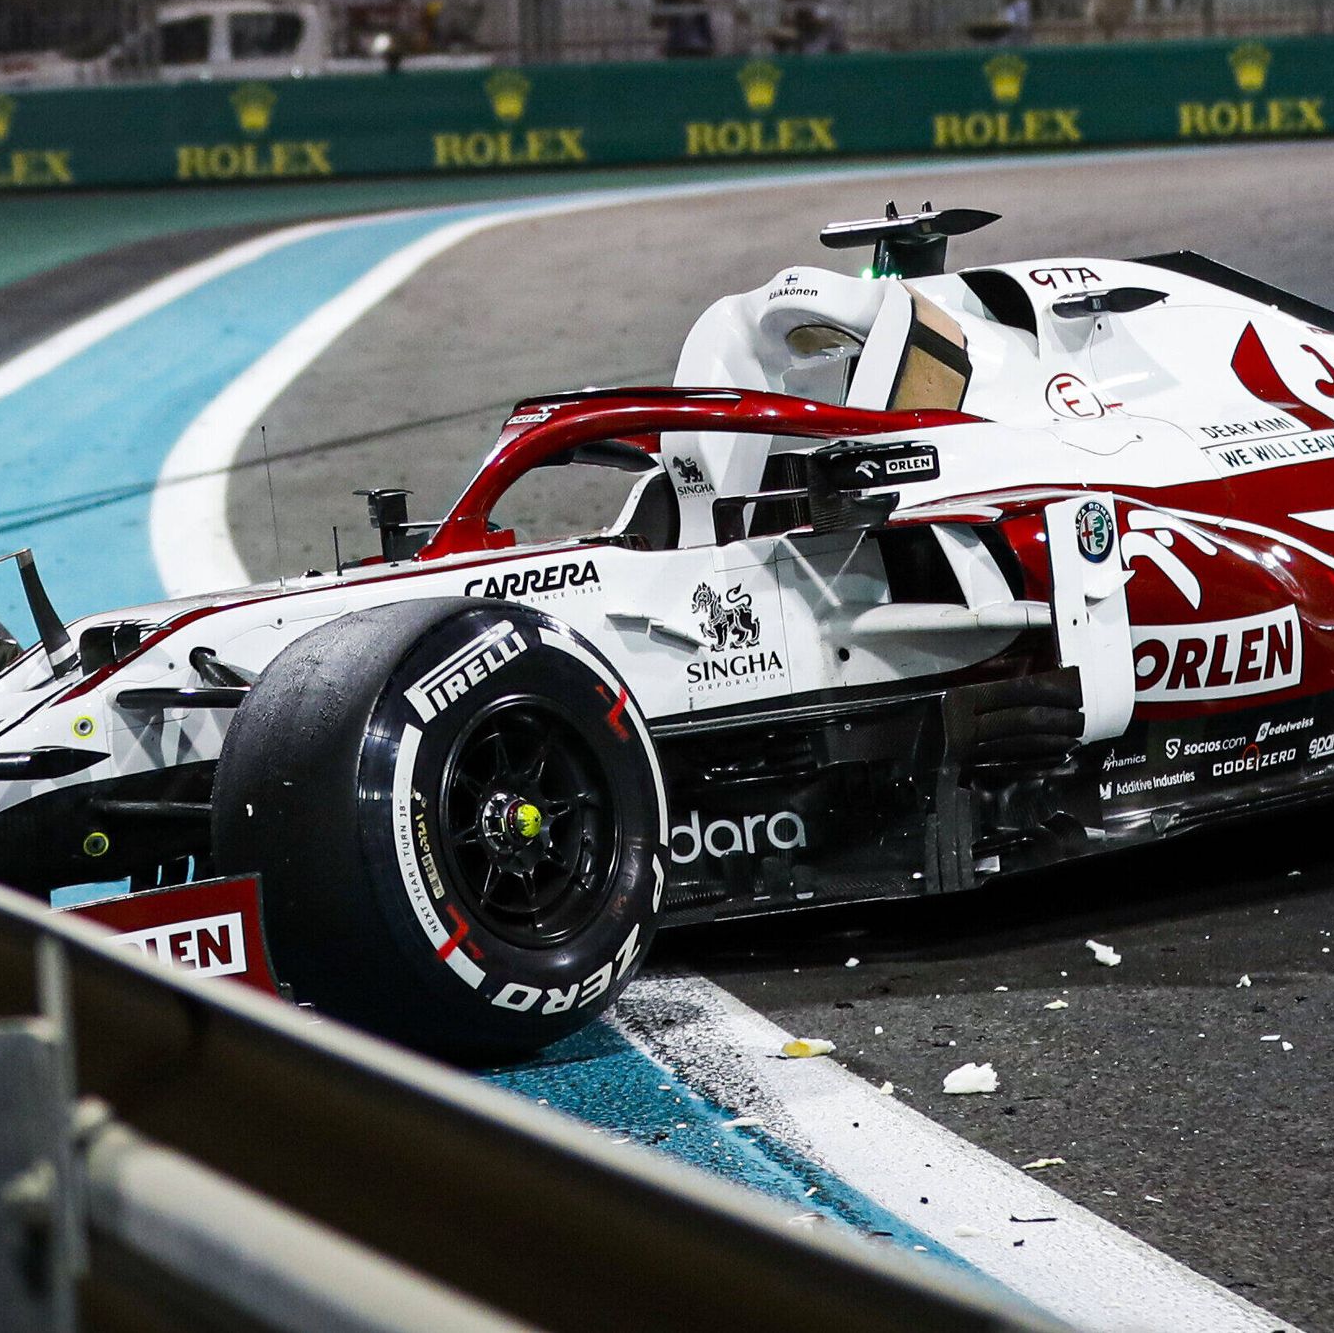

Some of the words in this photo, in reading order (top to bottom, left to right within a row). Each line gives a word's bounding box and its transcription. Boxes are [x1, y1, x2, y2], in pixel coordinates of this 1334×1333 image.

[933, 108, 1081, 147] ROLEX
[1179, 97, 1325, 136] ROLEX
[433, 128, 586, 166] ROLEX
[685, 117, 836, 156] ROLEX
[175, 141, 332, 178] ROLEX
[1029, 267, 1102, 289] GTA
[1200, 421, 1252, 439] DEAR
[1252, 417, 1295, 434] KIMI
[888, 458, 930, 472] ORLEN
[1219, 446, 1253, 468] WE
[1252, 440, 1295, 462] WILL
[677, 483, 715, 496] SINGHA
[464, 560, 601, 600] CARRERA
[530, 592, 565, 604] SINCE
[404, 619, 528, 724] PIRELLI
[686, 651, 783, 684] SINGHA
[1133, 619, 1293, 692] ORLEN
[688, 672, 786, 694] CORPORATION
[1268, 717, 1314, 736] edelweiss
[1116, 779, 1152, 796] Additive
[1152, 770, 1196, 788] Industries
[399, 825, 410, 857] TURN
[409, 871, 425, 902] YEAR
[652, 853, 665, 914] P
[421, 906, 439, 934] NEXT
[491, 923, 640, 1015] ZERO
